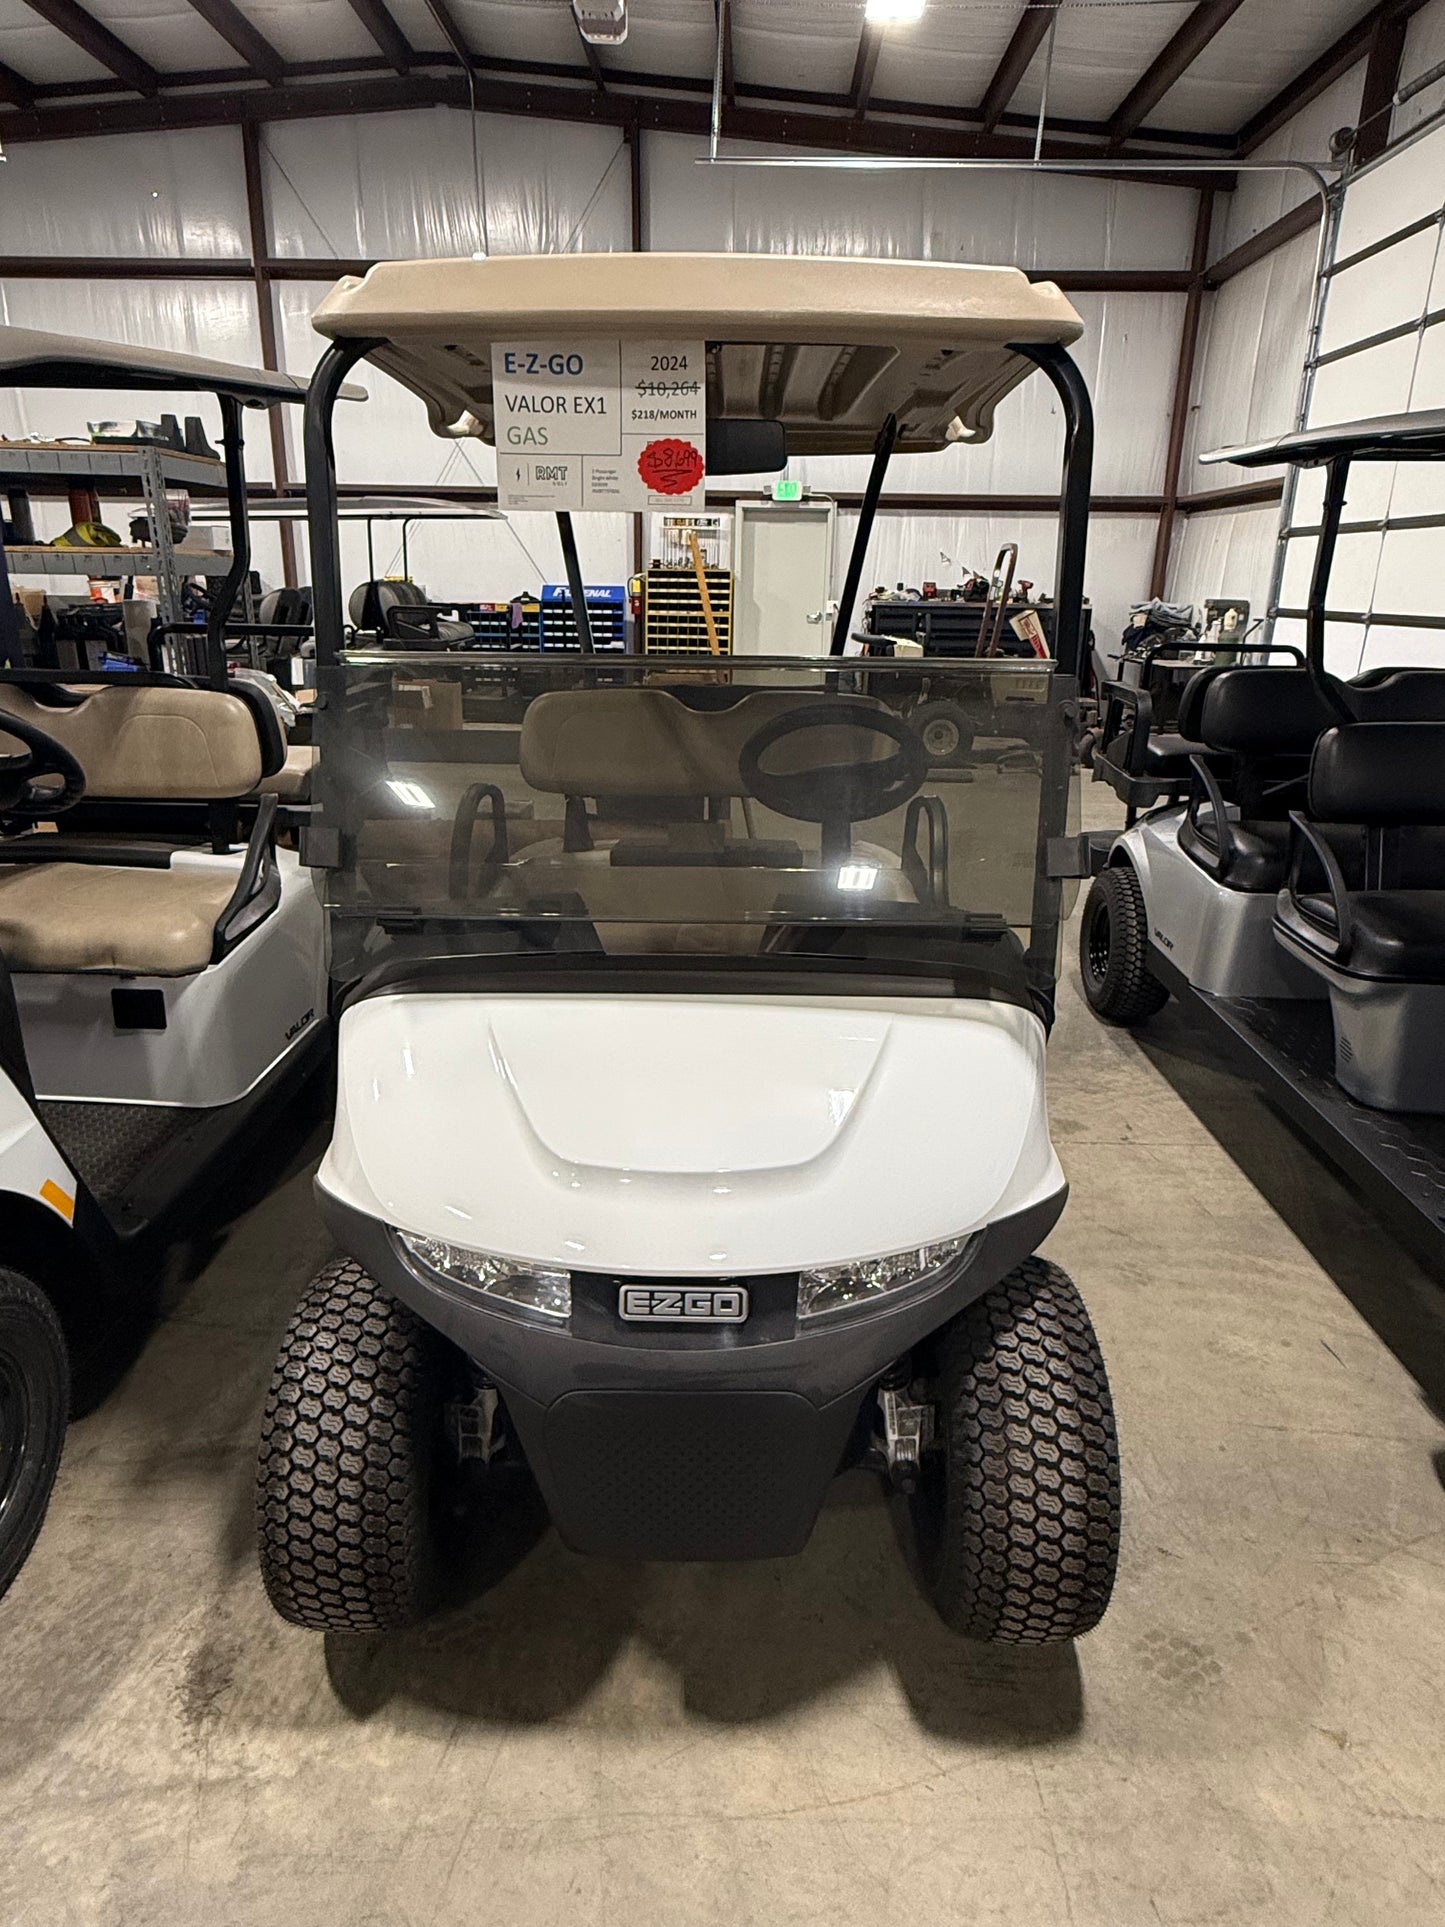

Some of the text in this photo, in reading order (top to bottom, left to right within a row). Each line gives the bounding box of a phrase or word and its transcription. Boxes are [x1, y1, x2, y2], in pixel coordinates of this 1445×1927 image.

[504, 352, 583, 375] E-Z-GO
[650, 355, 688, 371] 2024
[637, 379, 699, 399] $10,264
[504, 394, 607, 415] VALOR EX1
[631, 408, 697, 421] $218/MONTH
[507, 426, 549, 446] GAS
[535, 465, 568, 480] RMT
[285, 1007, 315, 1040] VALOR
[626, 1291, 740, 1316] EZGO
